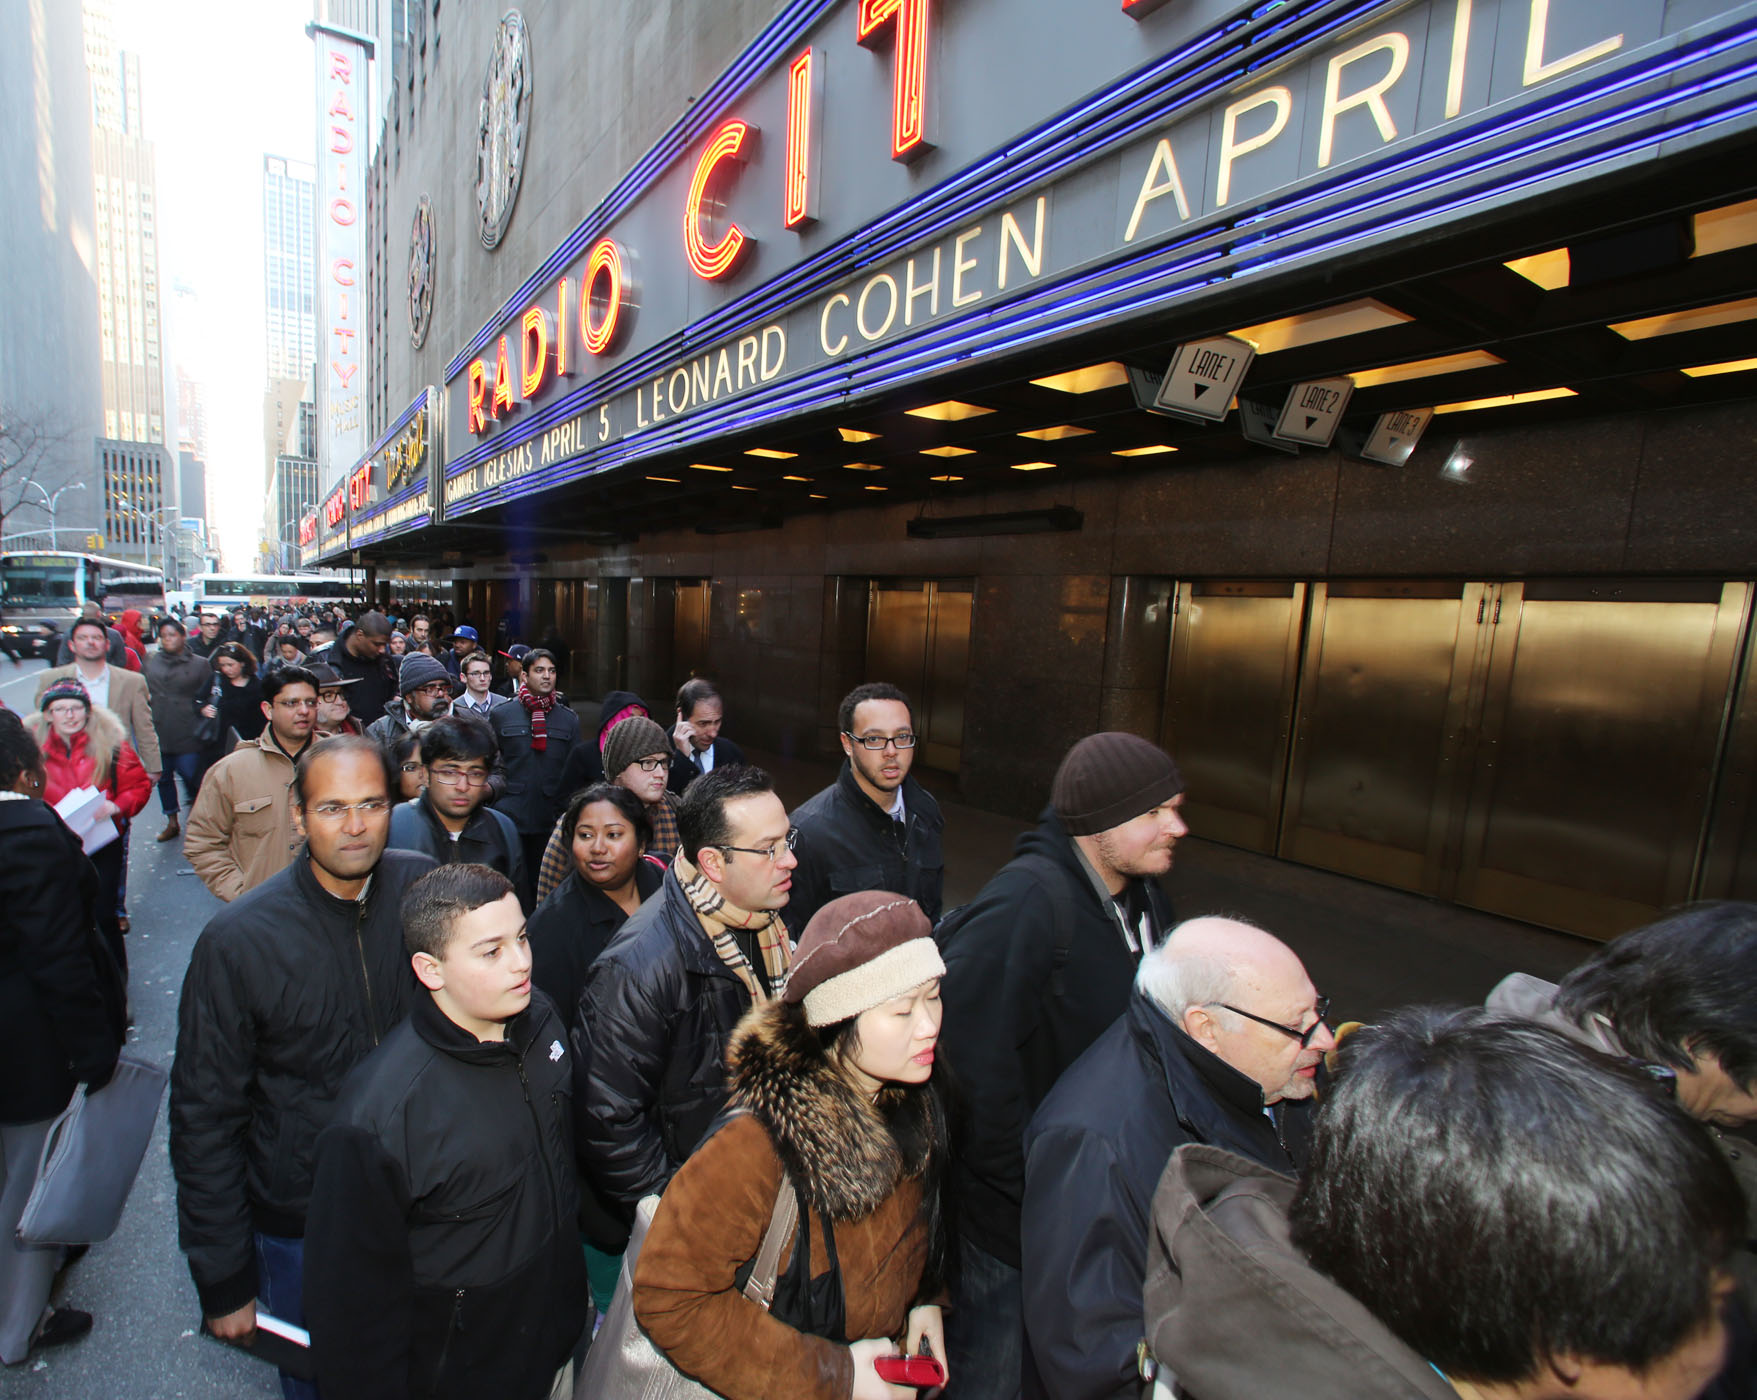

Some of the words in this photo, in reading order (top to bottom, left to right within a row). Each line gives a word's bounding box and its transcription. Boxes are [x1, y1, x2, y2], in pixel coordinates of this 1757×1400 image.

[329, 51, 356, 227] RADIO
[332, 257, 358, 388] CITY
[446, 468, 479, 502] GABRIEL
[483, 441, 533, 487] IGLESIAS
[541, 416, 585, 465] APRIL
[598, 404, 610, 442] 5
[636, 325, 787, 428] LEONARD
[820, 196, 1046, 357] COHEN
[1124, 0, 1624, 242] APRIL
[468, 237, 623, 433] RADIO
[1188, 348, 1228, 380] LANE
[1223, 358, 1236, 383] 1
[1300, 385, 1332, 411] LANE
[1326, 391, 1340, 413] 2
